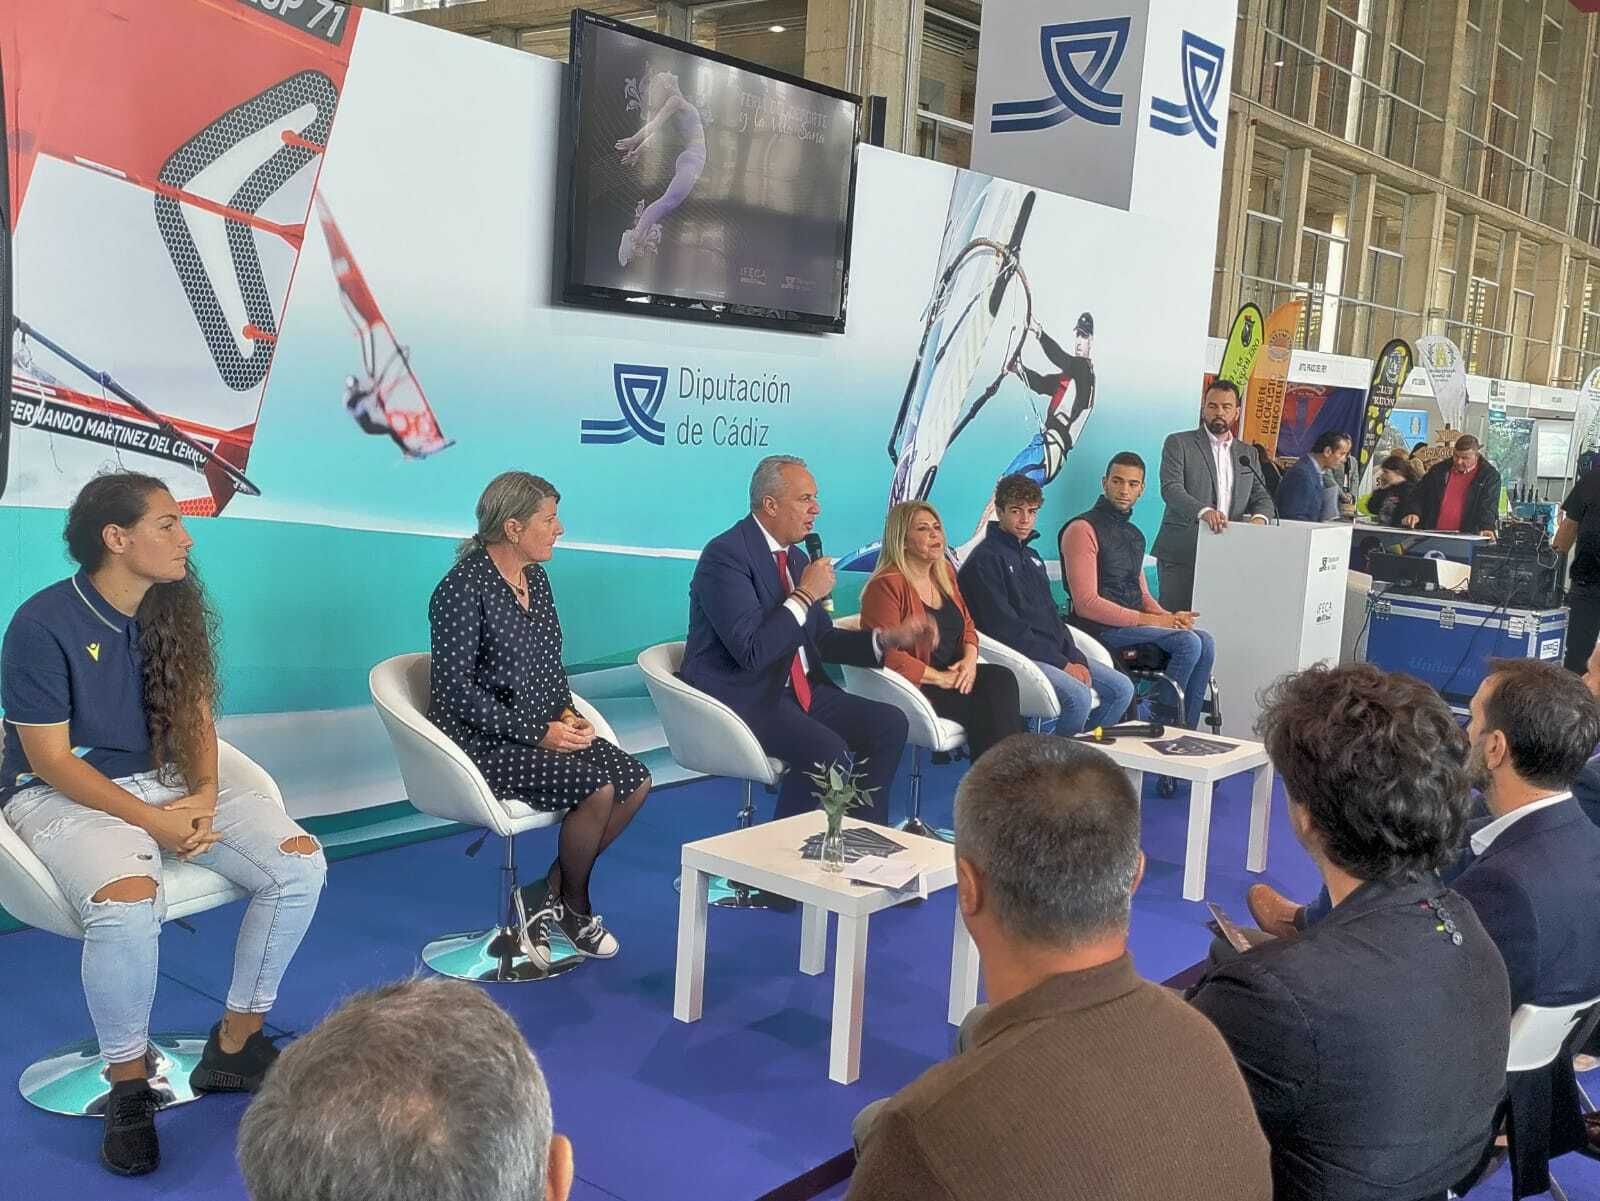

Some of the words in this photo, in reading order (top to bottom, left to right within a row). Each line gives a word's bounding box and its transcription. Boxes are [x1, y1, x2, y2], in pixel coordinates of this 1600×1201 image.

[306, 0, 345, 38] 71
[754, 108, 768, 129] la
[678, 367, 791, 406] Diputación
[10, 399, 84, 433] FERNANDO
[84, 418, 149, 448] MARTINEZ
[148, 434, 170, 454] DEL
[676, 415, 703, 446] de
[712, 415, 770, 447] Cádiz
